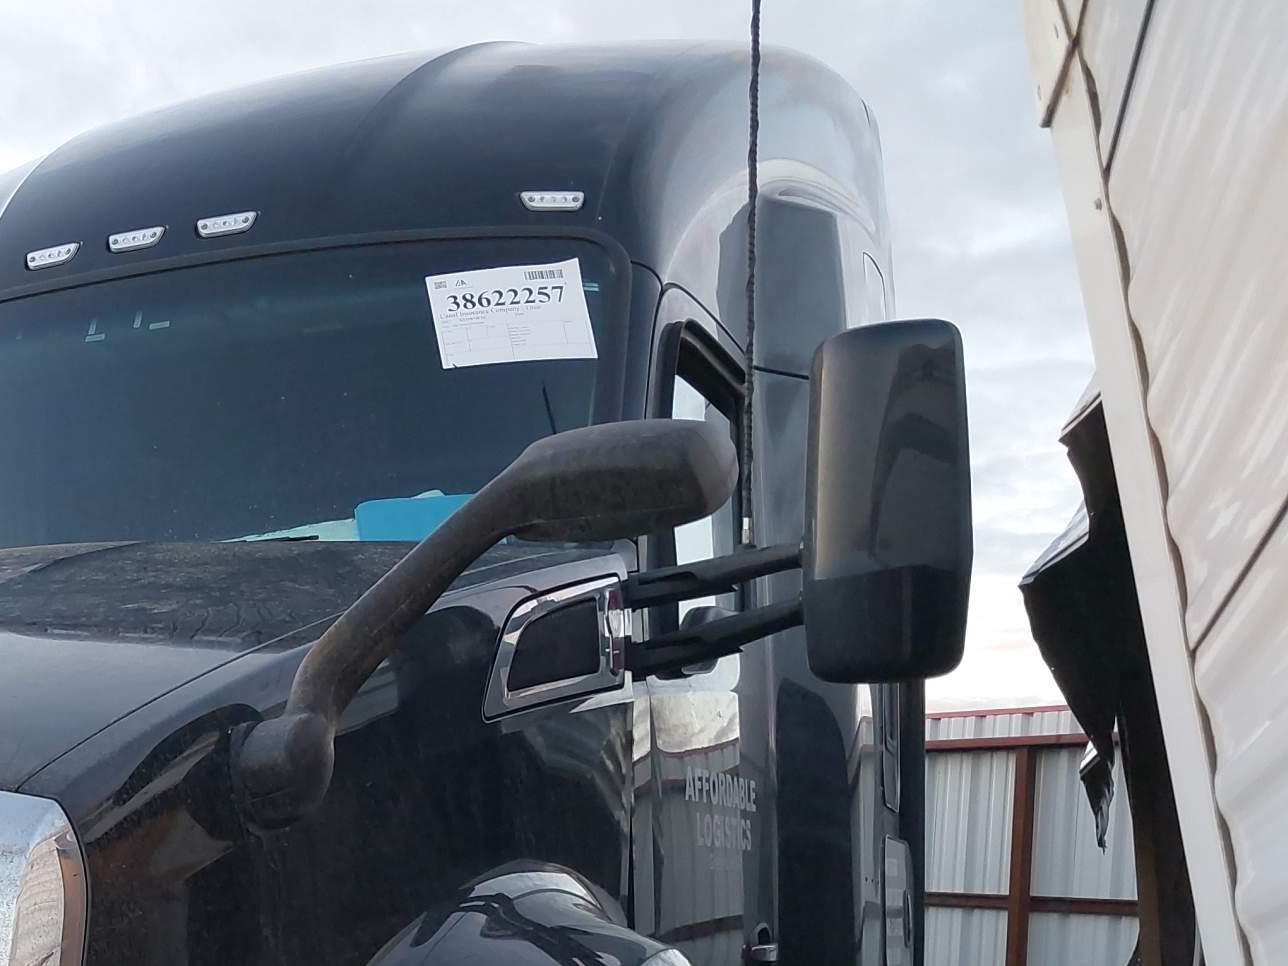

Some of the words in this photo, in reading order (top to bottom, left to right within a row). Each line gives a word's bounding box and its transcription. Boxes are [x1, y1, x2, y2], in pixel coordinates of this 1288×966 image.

[447, 286, 564, 312] 38622257
[685, 766, 757, 812] AFFORDABLE
[695, 812, 752, 851] LOGISTICS
